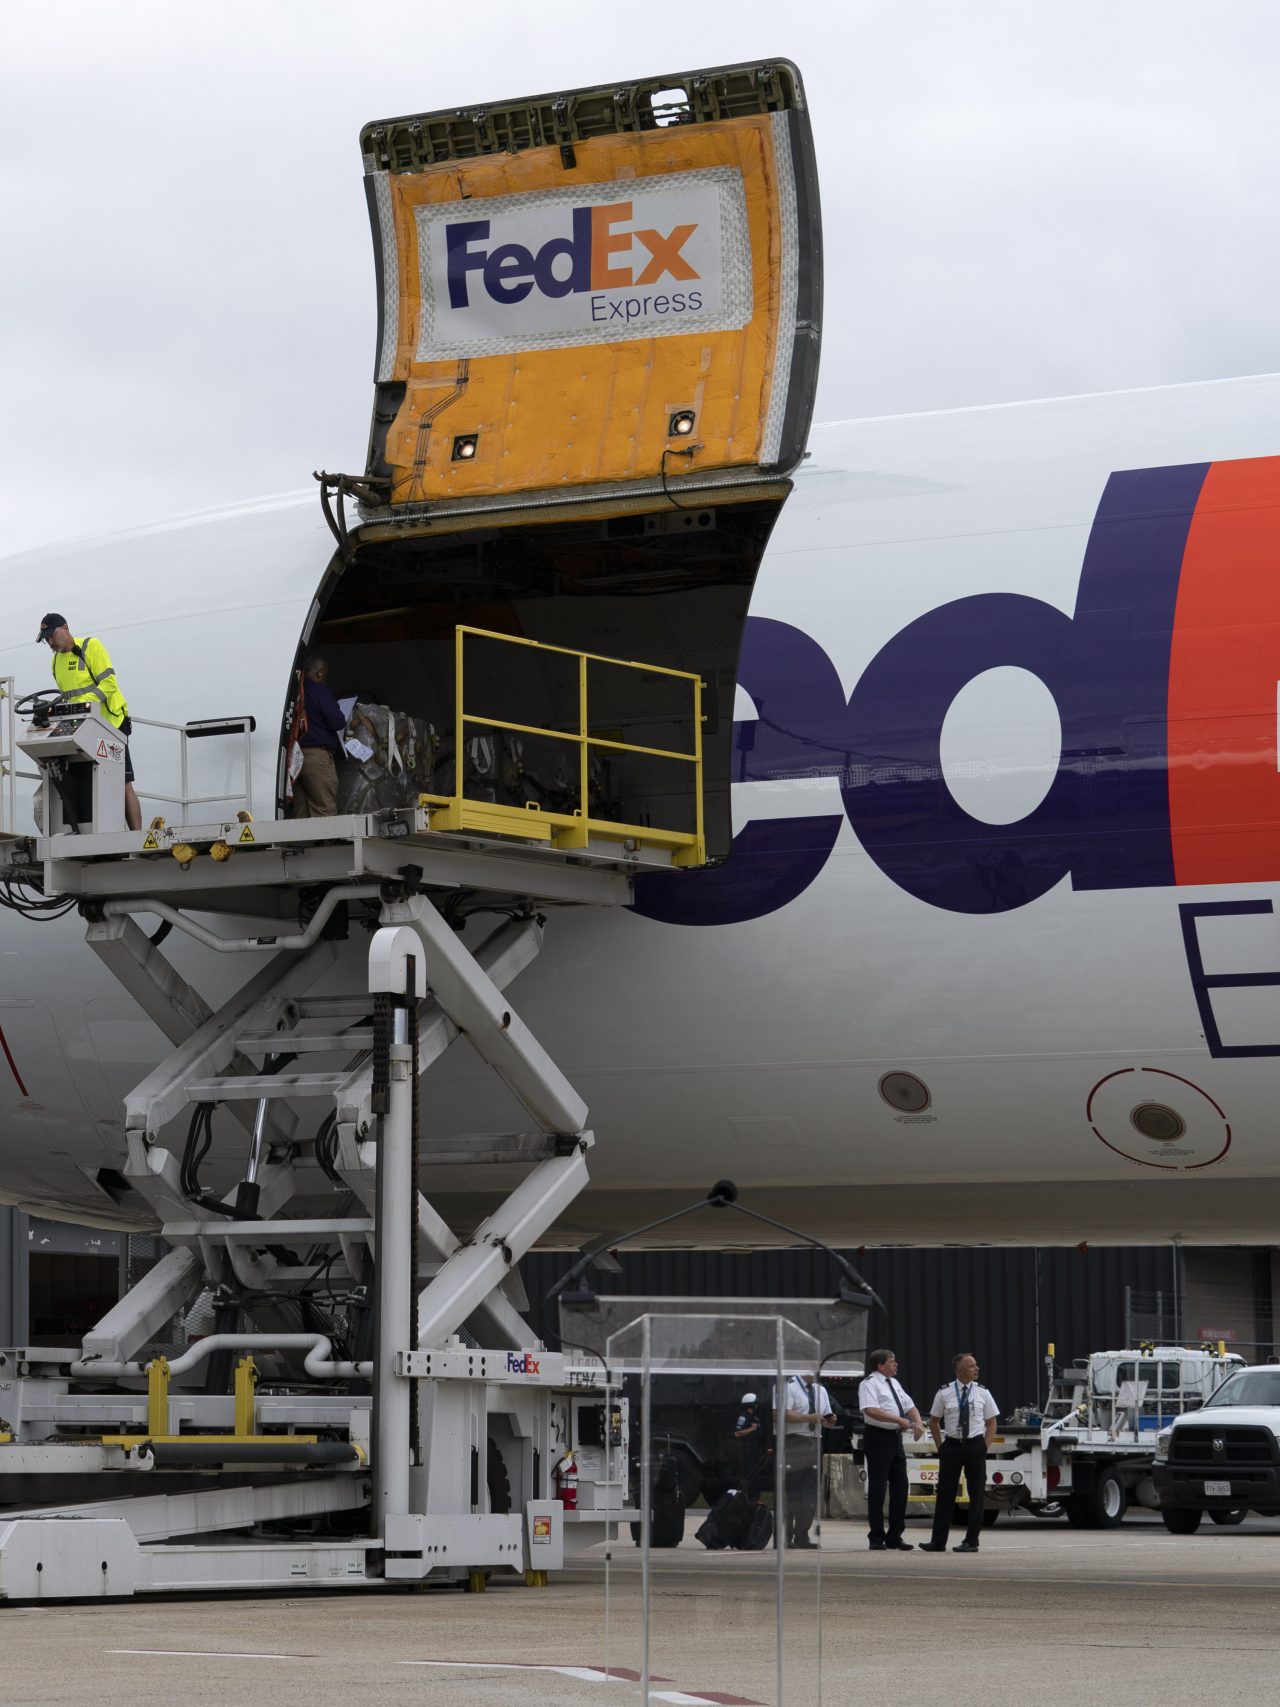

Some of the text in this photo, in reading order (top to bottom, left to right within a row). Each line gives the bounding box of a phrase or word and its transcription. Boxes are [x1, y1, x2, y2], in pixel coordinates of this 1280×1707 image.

[445, 201, 701, 309] FedEx
[590, 291, 702, 322] Express
[507, 1352, 540, 1374] FedEx
